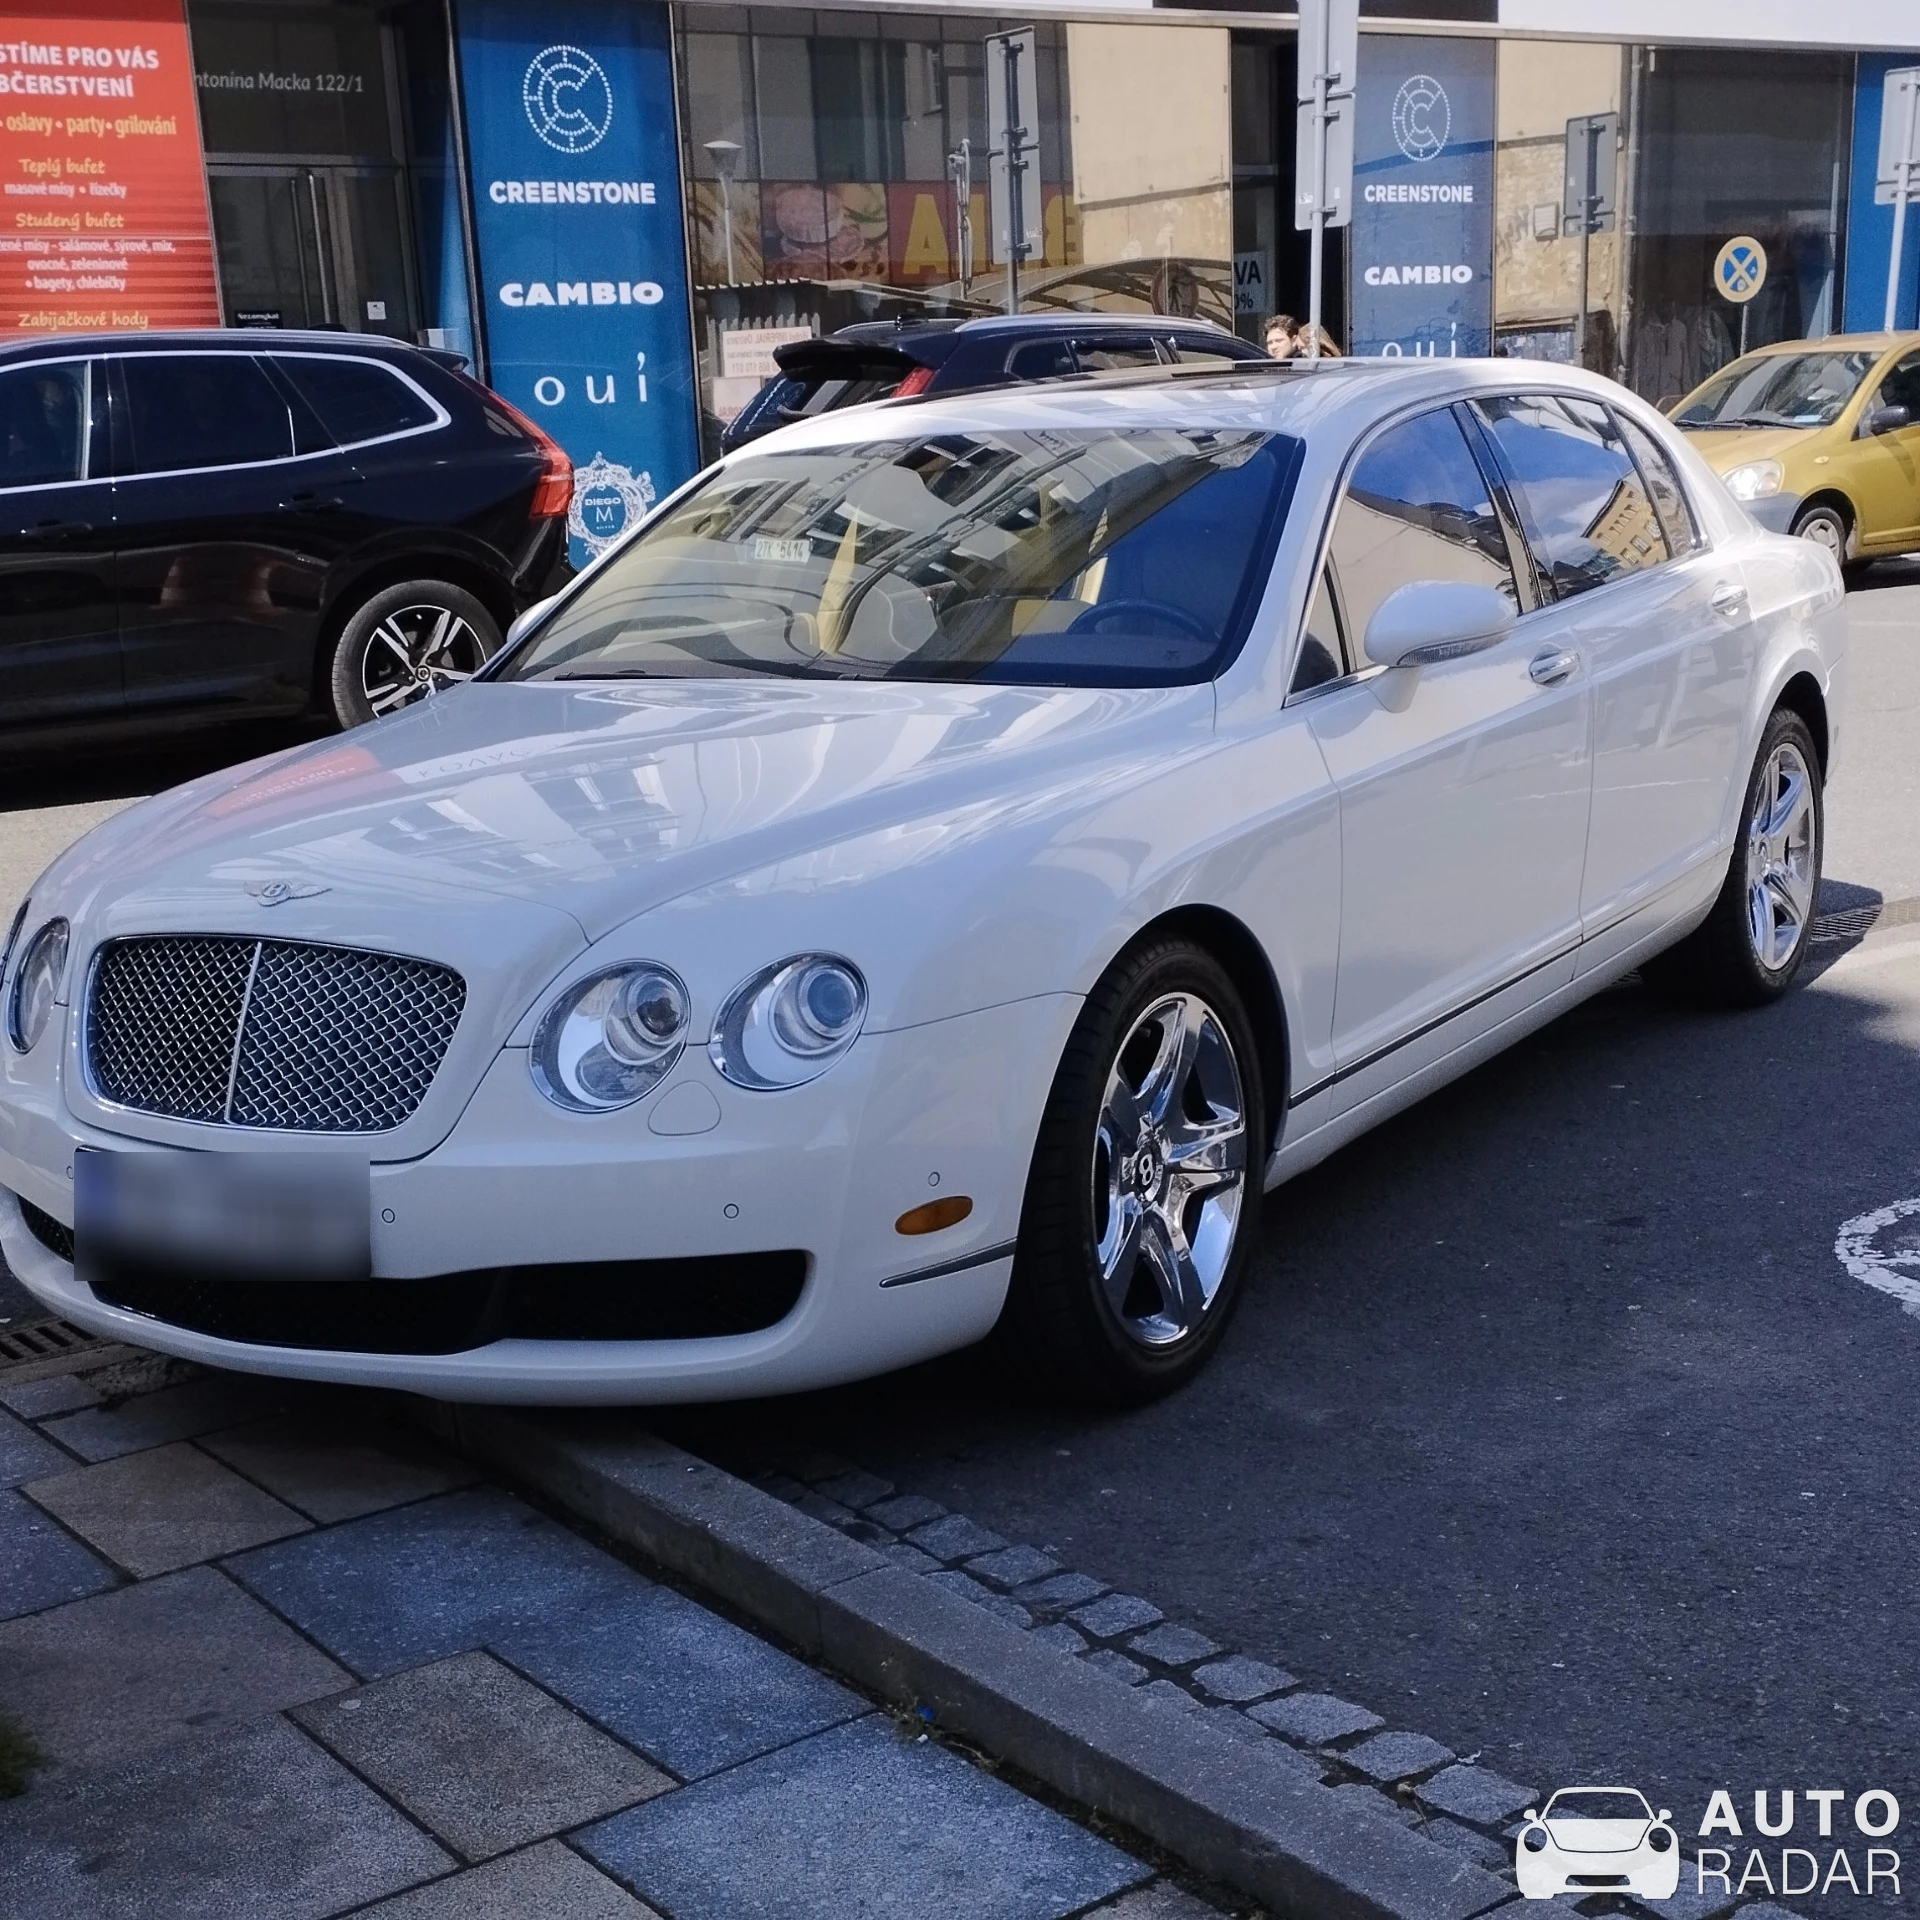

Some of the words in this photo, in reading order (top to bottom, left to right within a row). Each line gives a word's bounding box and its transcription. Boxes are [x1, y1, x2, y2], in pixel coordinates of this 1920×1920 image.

[67, 46, 113, 67] PRO
[116, 45, 160, 69] VÁS
[258, 72, 311, 90] Macka
[315, 74, 364, 93] 122/1
[6, 112, 53, 137] oslavy
[66, 116, 105, 138] party
[115, 114, 177, 138] grilování
[18, 157, 61, 178] Teplý
[66, 157, 105, 174] bufet
[489, 181, 656, 204] CREENSTONE
[1364, 185, 1473, 203] CREENSTONE
[16, 213, 80, 231] Studený
[85, 212, 124, 228] bufet
[1233, 260, 1262, 285] VA
[1364, 265, 1473, 286] CAMBIO
[499, 282, 664, 306] CAMBIO
[112, 310, 148, 330] hody
[585, 497, 621, 506] DIEGO
[596, 506, 614, 522] M
